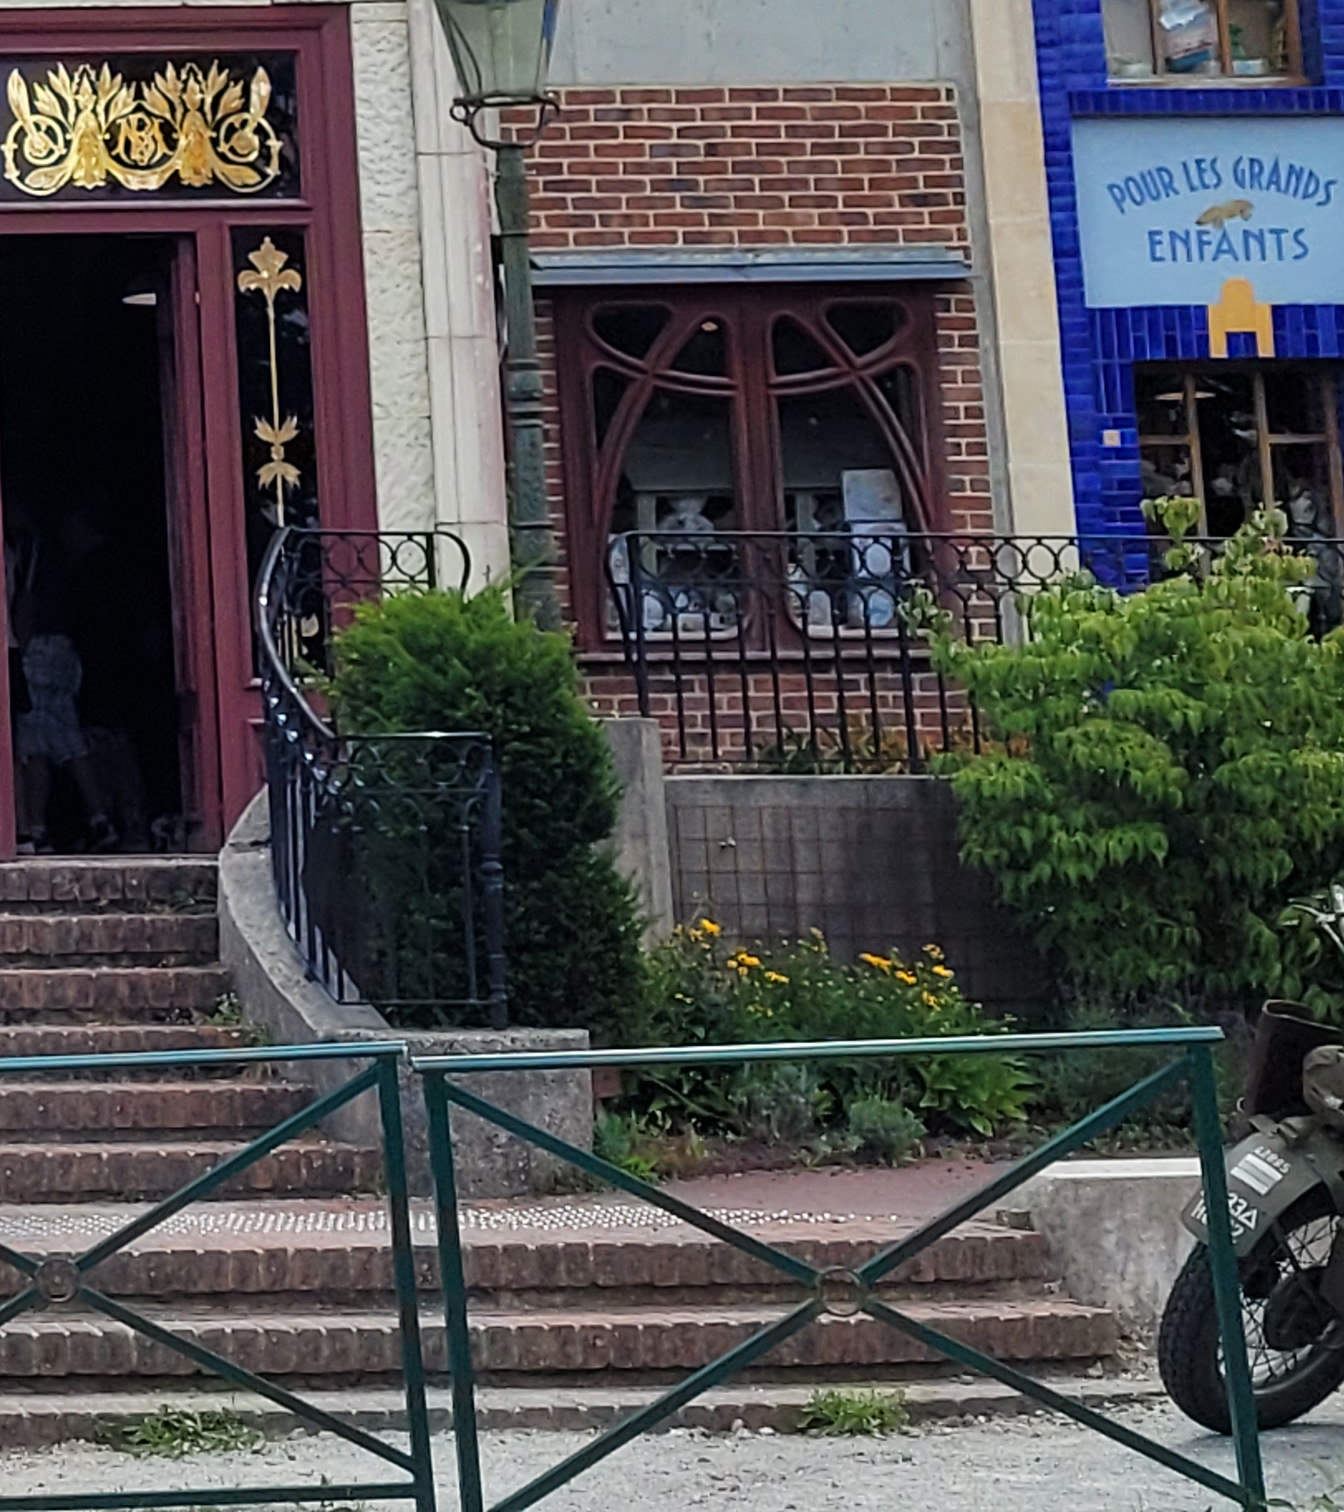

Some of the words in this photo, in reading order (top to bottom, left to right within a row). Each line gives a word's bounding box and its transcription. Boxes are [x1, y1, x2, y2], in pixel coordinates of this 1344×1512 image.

[1107, 165, 1180, 214] POUR
[1181, 156, 1223, 193] LES
[1232, 154, 1338, 207] GRANDS
[1147, 228, 1310, 262] ENFANTS
